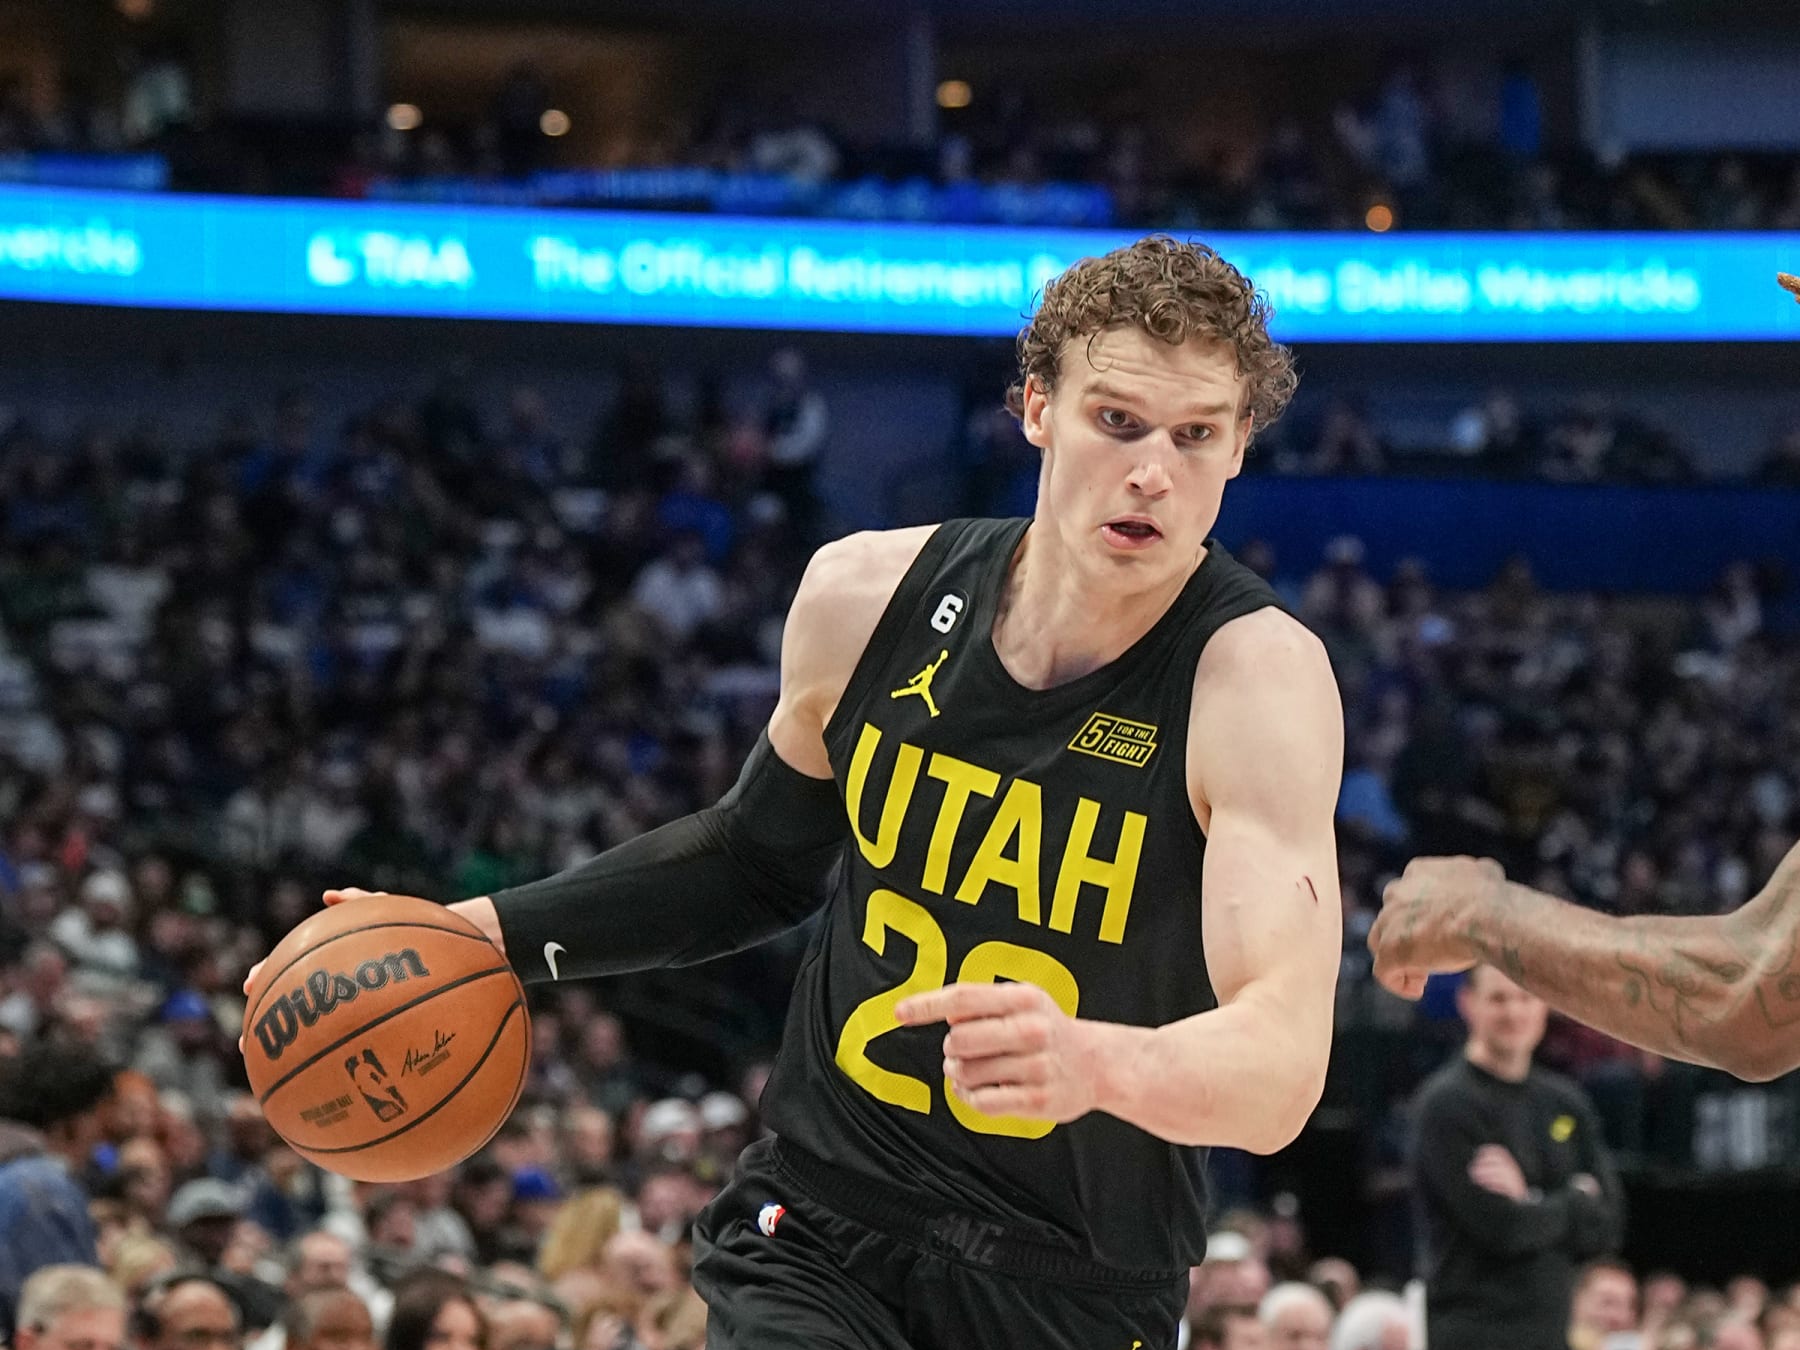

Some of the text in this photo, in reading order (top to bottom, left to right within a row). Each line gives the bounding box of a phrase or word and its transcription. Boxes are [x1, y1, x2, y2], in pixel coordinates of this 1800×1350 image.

[357, 229, 474, 288] TIAA
[531, 235, 616, 292] The
[617, 238, 784, 298] Official
[787, 246, 1024, 306] Retirement
[1335, 261, 1471, 313] Dallas
[1477, 262, 1700, 314] Mavericks
[930, 593, 963, 634] 6
[1080, 719, 1112, 748] 5
[1103, 739, 1148, 761] FIGHT
[1117, 725, 1151, 740] FOR THE
[845, 722, 1147, 944] UTAH
[253, 946, 429, 1061] Wilson
